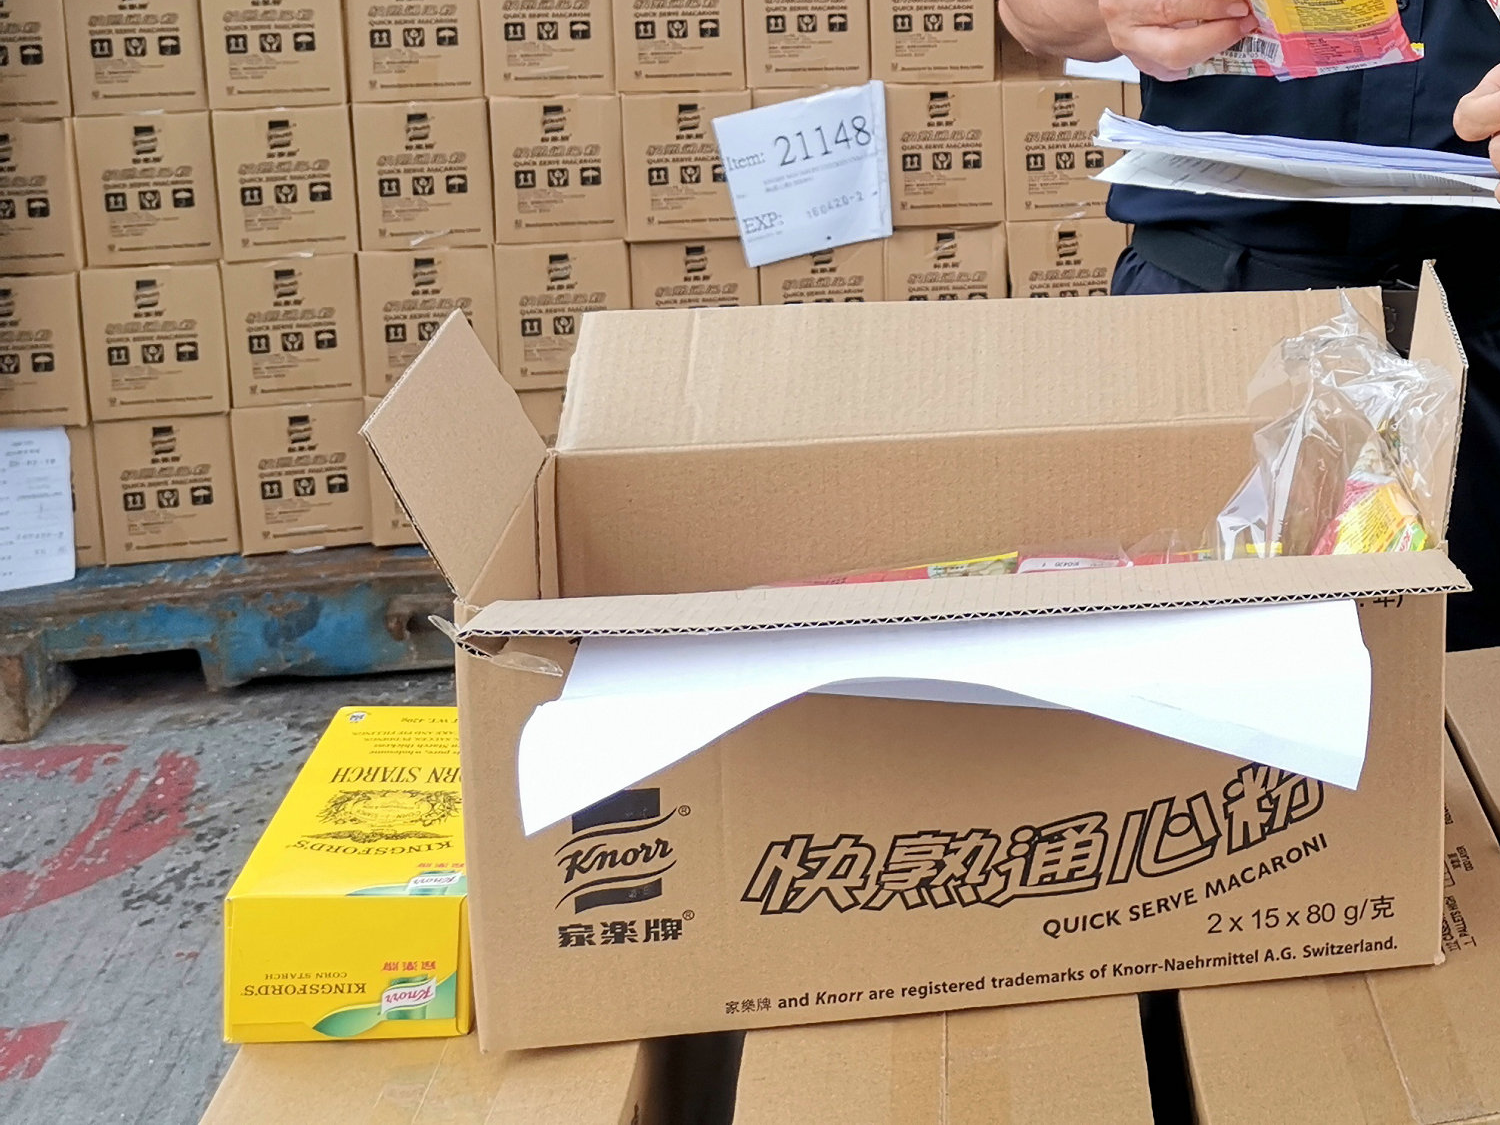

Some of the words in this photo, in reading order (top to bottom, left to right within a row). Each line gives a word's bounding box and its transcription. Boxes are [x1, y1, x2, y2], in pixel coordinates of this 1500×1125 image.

[726, 152, 765, 171] Item:
[774, 115, 872, 167] 21148
[330, 767, 421, 783] STARCH
[426, 767, 461, 783] RN
[740, 761, 1326, 915] 快熟通心粉
[294, 839, 454, 857] KINGSFORD'S
[564, 837, 674, 885] Knorr
[1042, 908, 1121, 939] QUICK
[1129, 888, 1198, 922] SERVE
[1204, 832, 1329, 900] MACARONI
[1207, 913, 1223, 934] 2
[1229, 915, 1244, 932] x
[1251, 907, 1280, 930] 15
[1286, 909, 1301, 927] x
[1306, 902, 1336, 924] 80
[1343, 894, 1396, 926] g/克
[265, 971, 302, 980] STARCH
[304, 971, 347, 980] CORN
[777, 992, 810, 1010] and
[815, 989, 864, 1005] Knorr
[868, 986, 895, 1001] are
[901, 975, 986, 997] registered
[990, 966, 1085, 989] trademarks
[1089, 964, 1108, 980] of
[1112, 949, 1260, 978] Knorr-Naehrmittel
[1264, 947, 1297, 964] A.G.
[1302, 936, 1398, 959] Switzerland.
[244, 983, 367, 996] KINGSFORD'S
[384, 984, 434, 1003] Knorr
